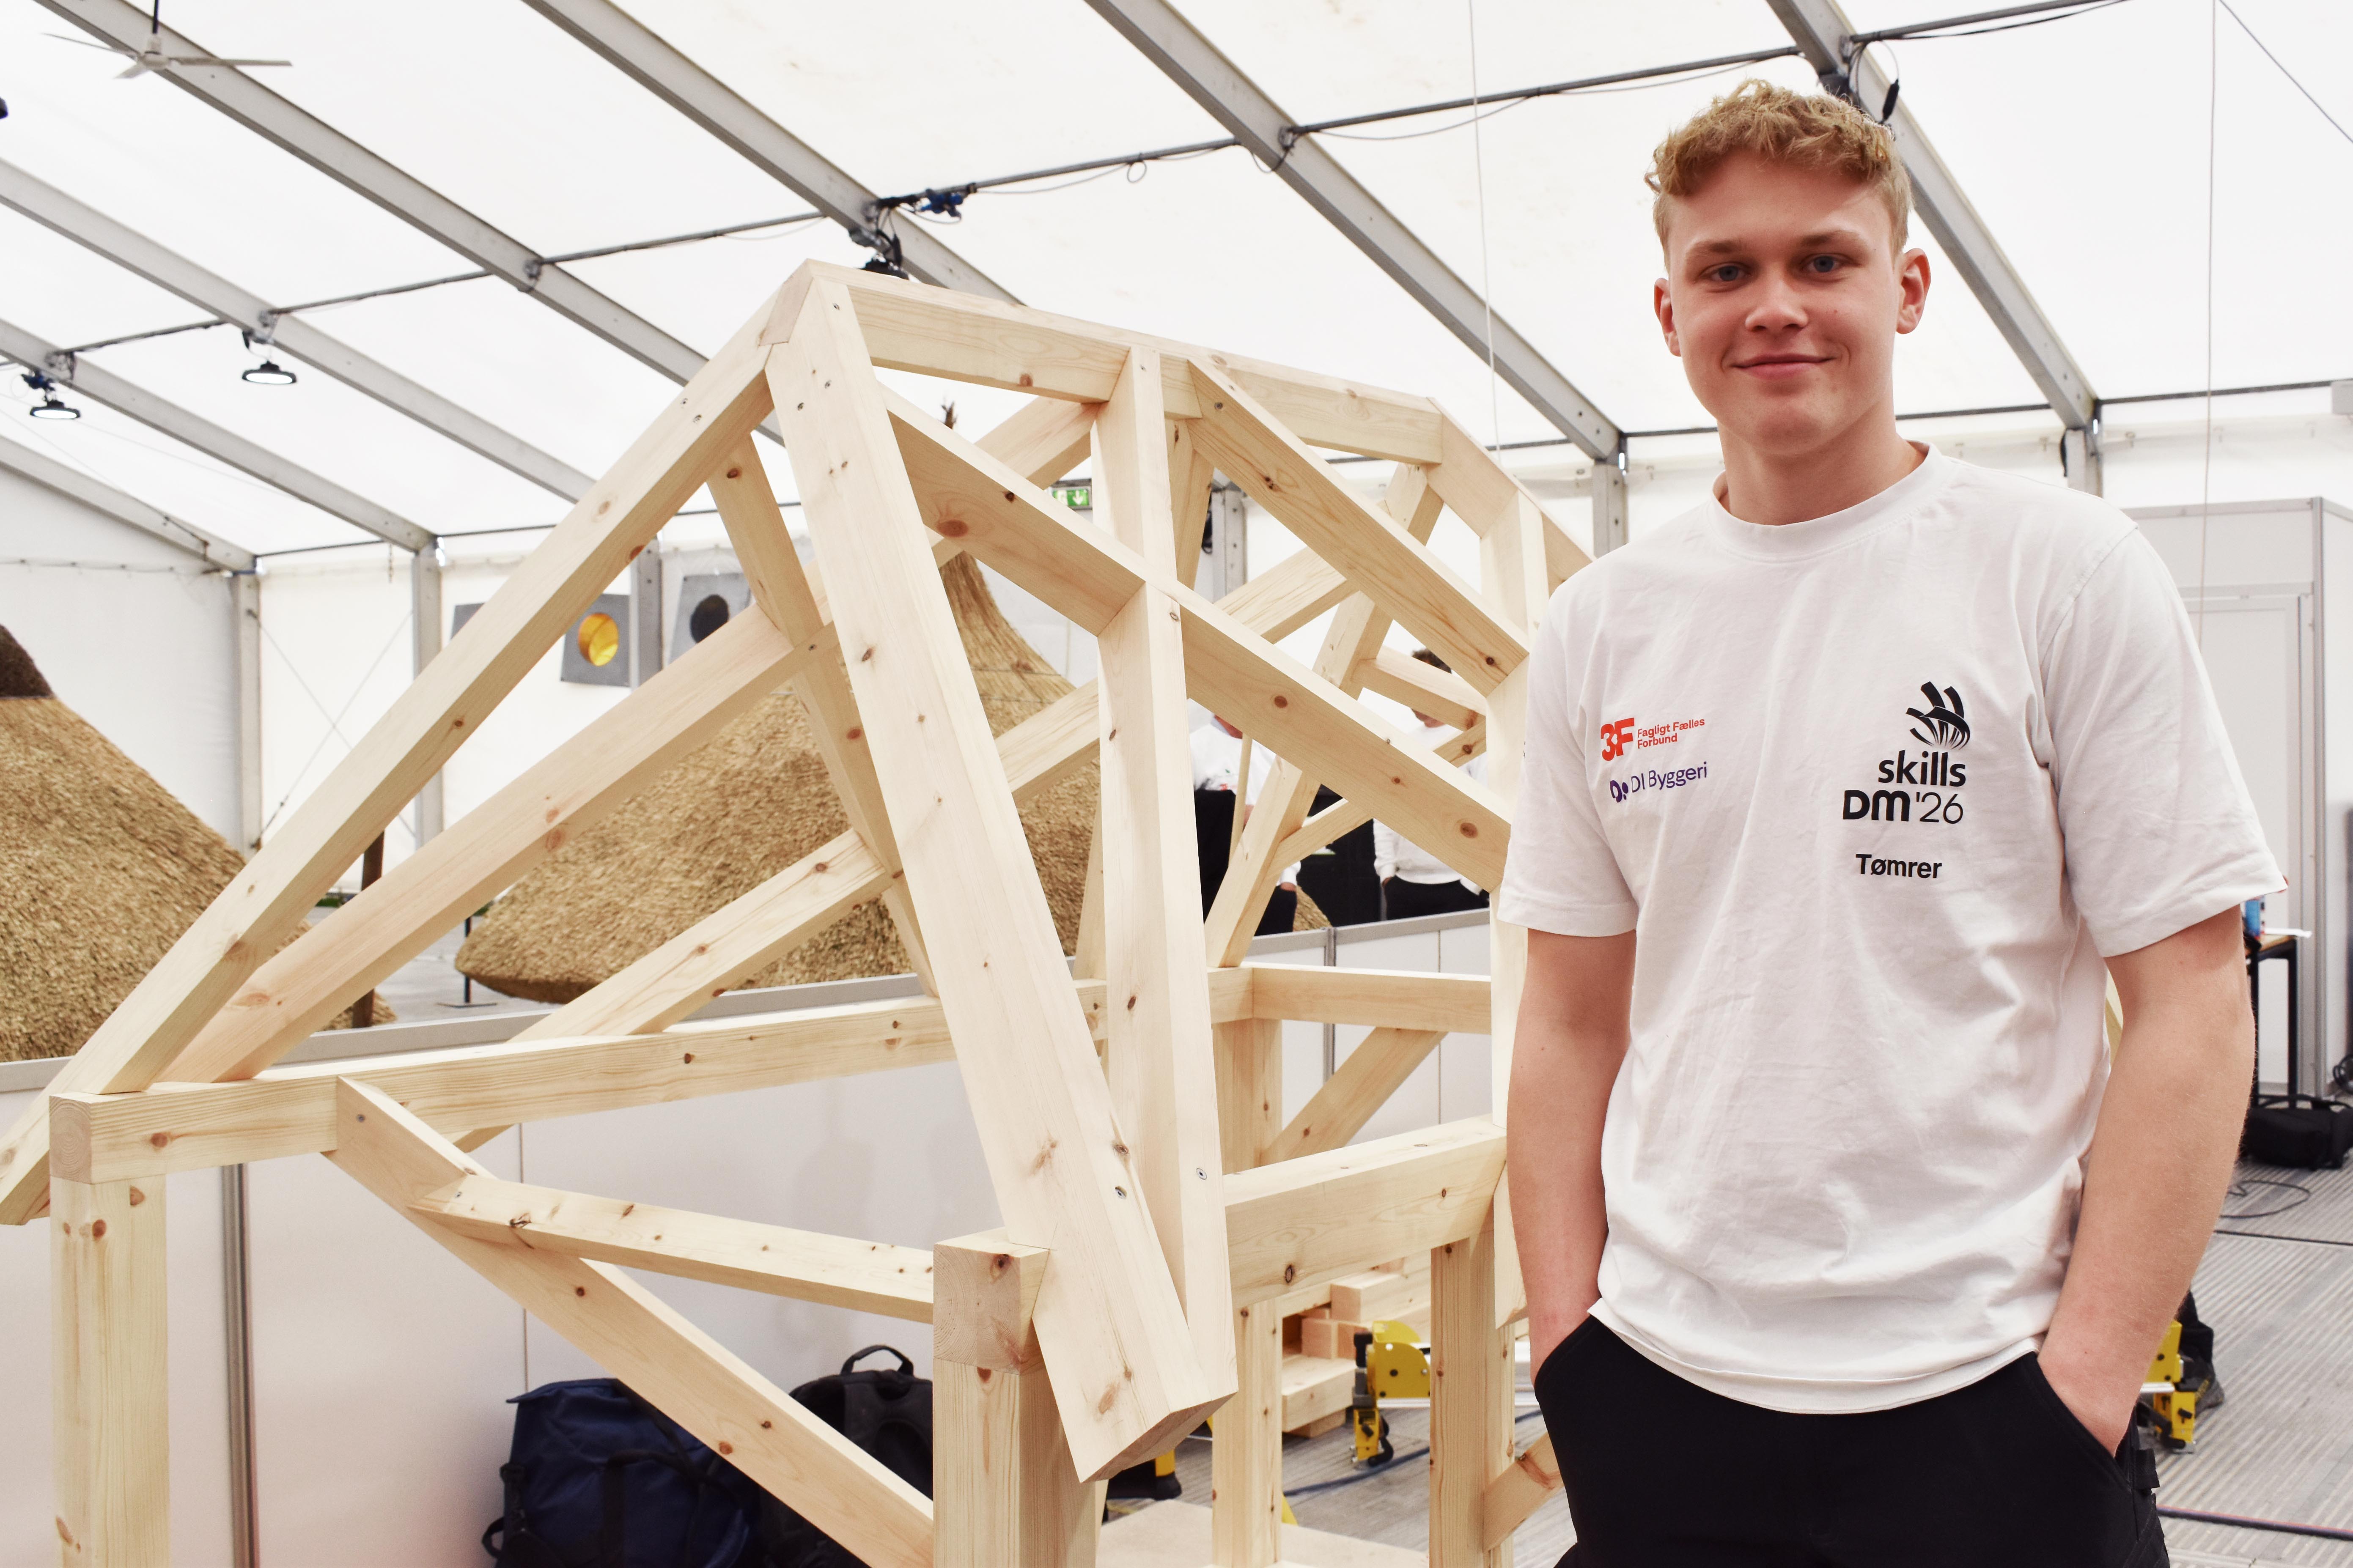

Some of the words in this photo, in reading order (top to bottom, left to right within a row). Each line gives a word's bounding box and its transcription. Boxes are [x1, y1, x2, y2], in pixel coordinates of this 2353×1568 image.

[1600, 717, 1635, 761] 3F
[1637, 724, 1670, 738] Fagligt
[1673, 719, 1705, 731] Fælles
[1637, 732, 1678, 749] Forbund
[1631, 773, 1645, 793] DI
[1649, 761, 1707, 790] Byggeri
[1878, 750, 1966, 787] skills
[1855, 854, 1942, 879] Tømrer
